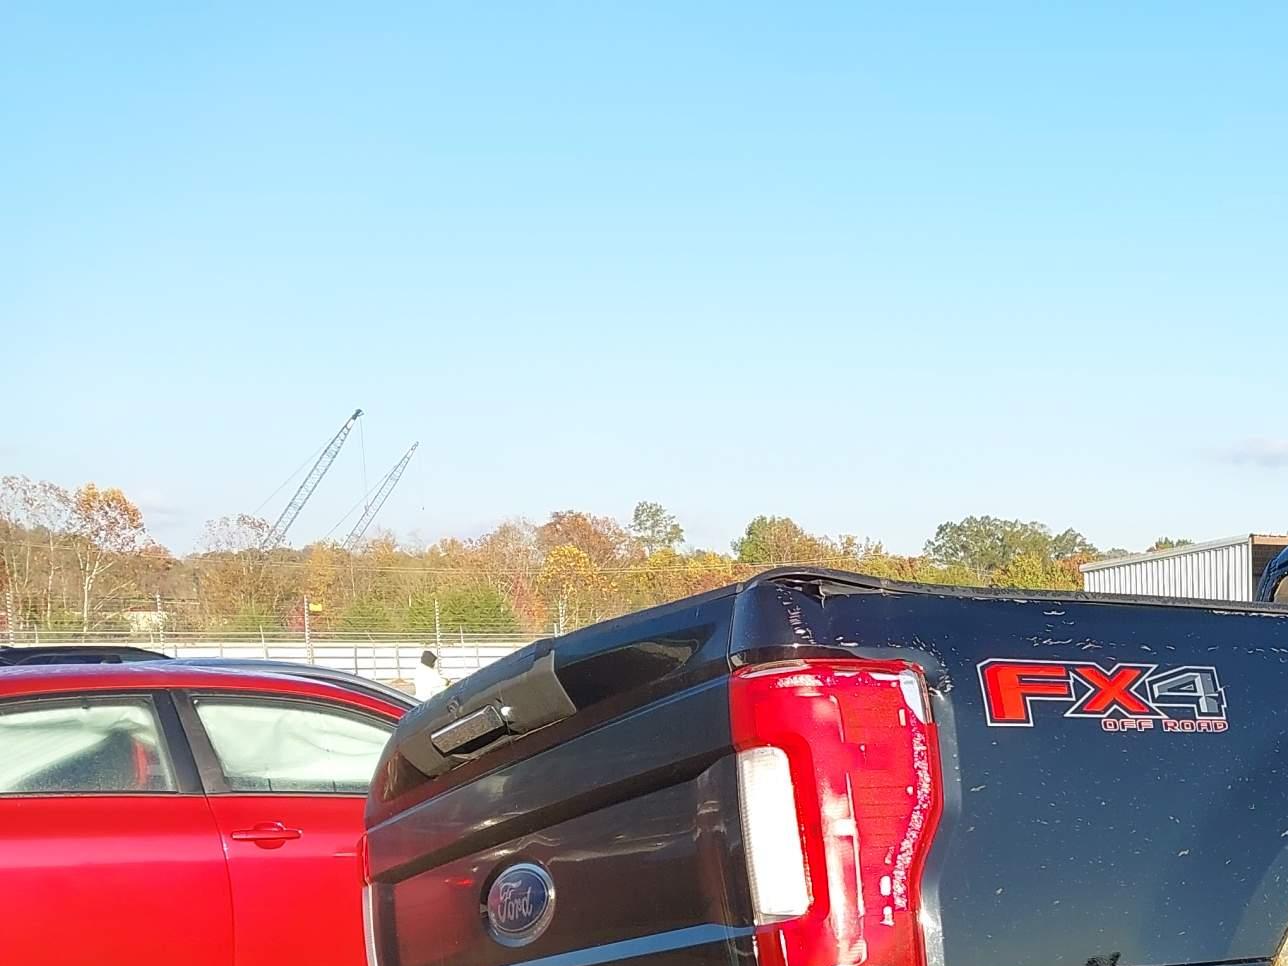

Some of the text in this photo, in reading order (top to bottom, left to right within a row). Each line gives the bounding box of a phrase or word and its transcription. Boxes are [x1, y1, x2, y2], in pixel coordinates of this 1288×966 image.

[976, 658, 1227, 727] FX4
[1101, 717, 1229, 733] OFF ROAD
[497, 879, 533, 924] Ford
